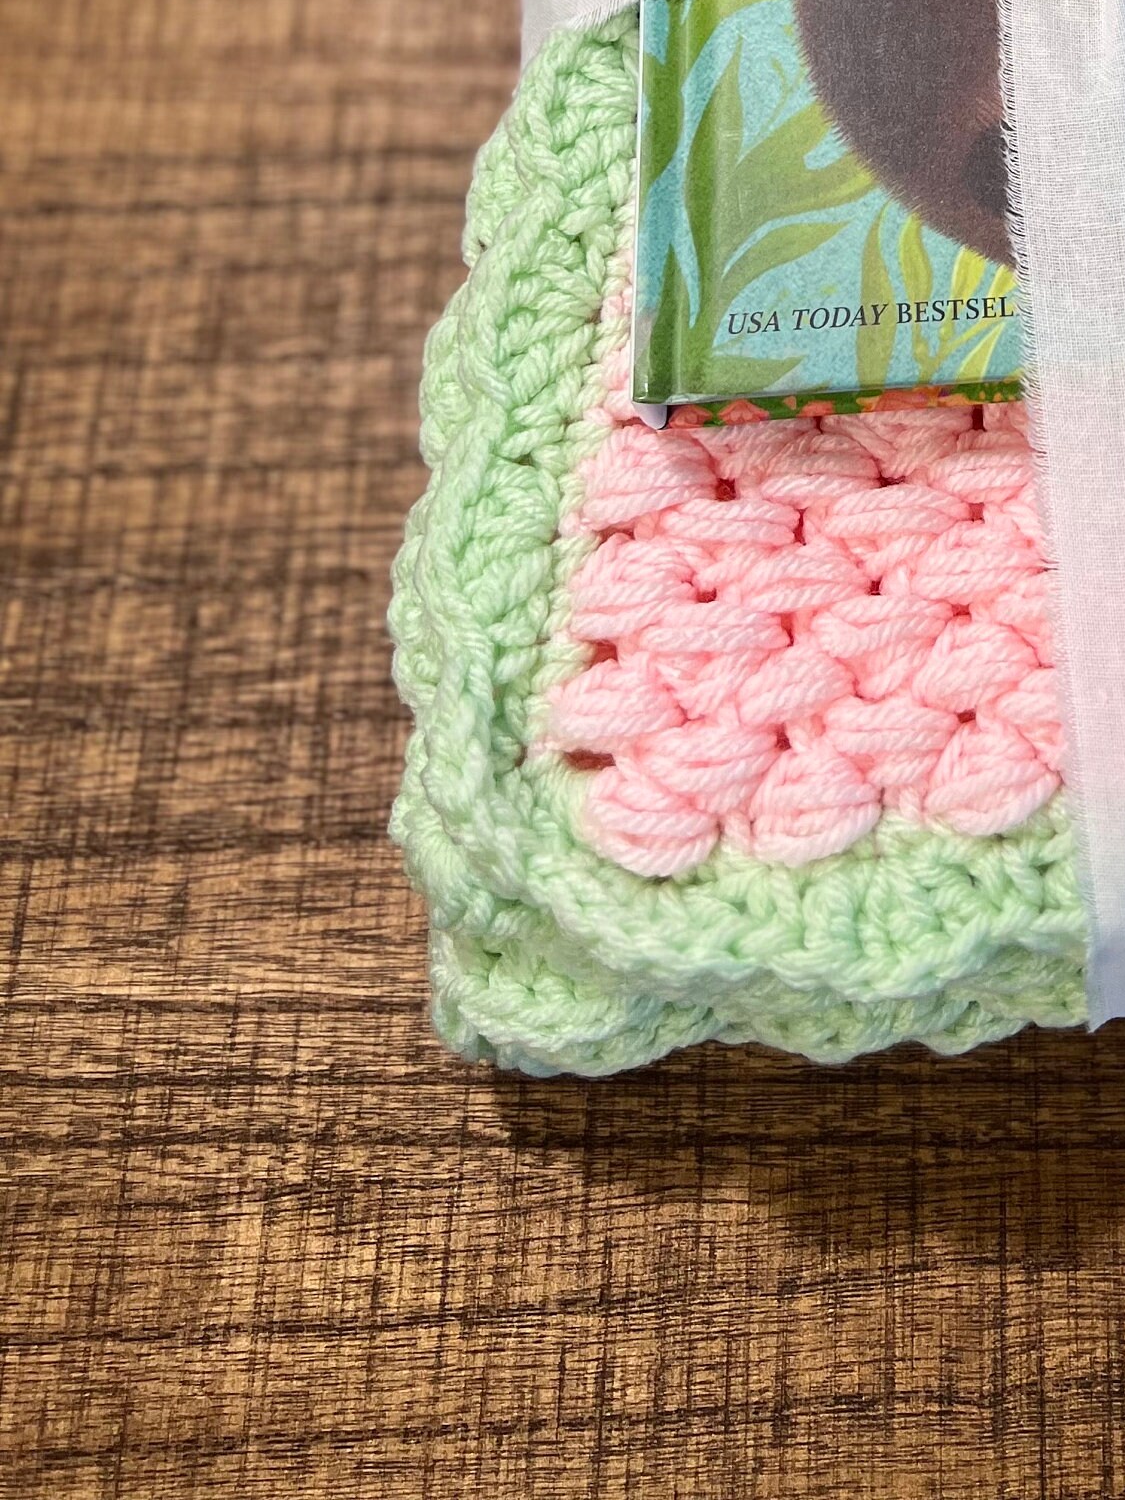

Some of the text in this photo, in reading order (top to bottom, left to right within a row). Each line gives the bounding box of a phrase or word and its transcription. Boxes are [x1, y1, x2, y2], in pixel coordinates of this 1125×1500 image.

[727, 295, 1016, 335] USA TODAY BESTSEL
